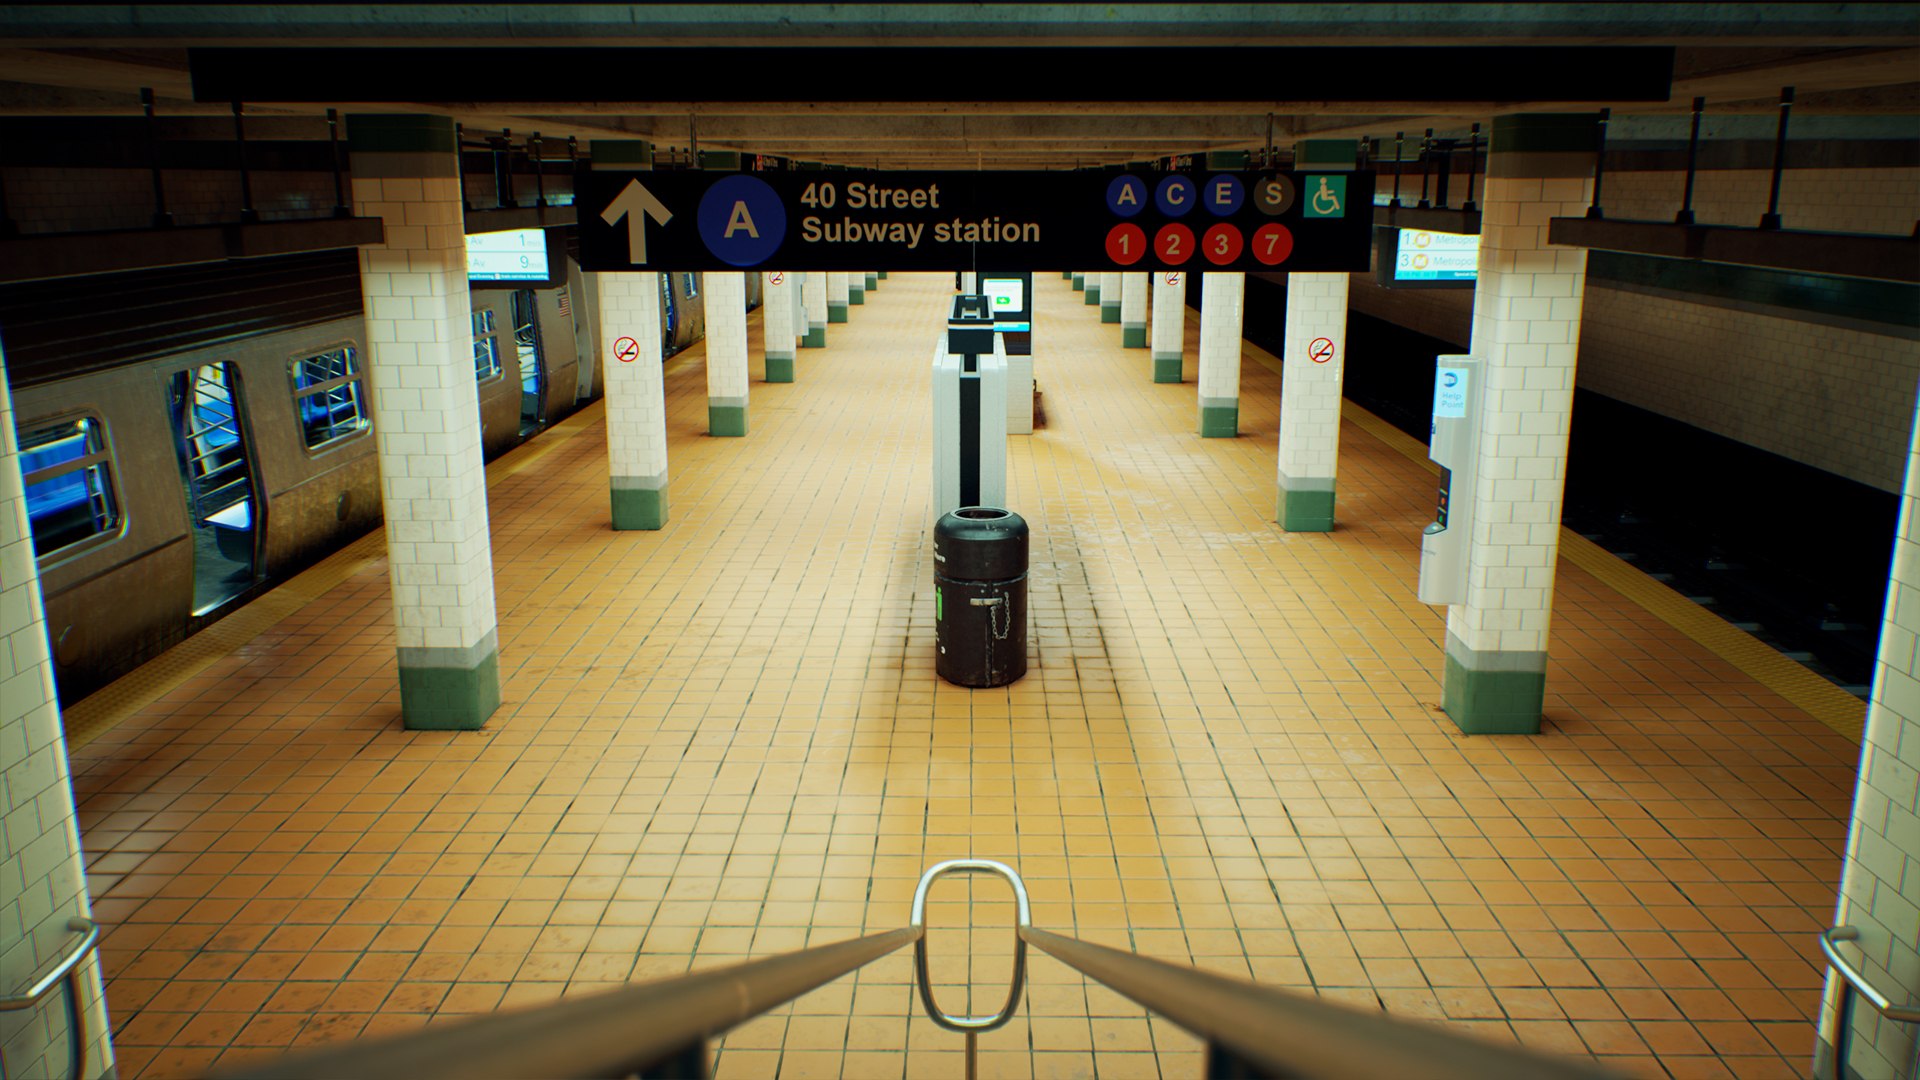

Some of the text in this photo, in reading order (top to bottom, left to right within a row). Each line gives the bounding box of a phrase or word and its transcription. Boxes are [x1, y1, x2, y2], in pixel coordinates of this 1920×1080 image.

[801, 183, 940, 209] 40 Street
[1117, 183, 1282, 205] A C E S
[724, 201, 759, 238] A
[802, 217, 1040, 250] Subway station
[1118, 234, 1279, 255] 1 2 3 7
[520, 255, 529, 269] 9
[1441, 400, 1464, 409] Point
[1442, 391, 1462, 401] Help
